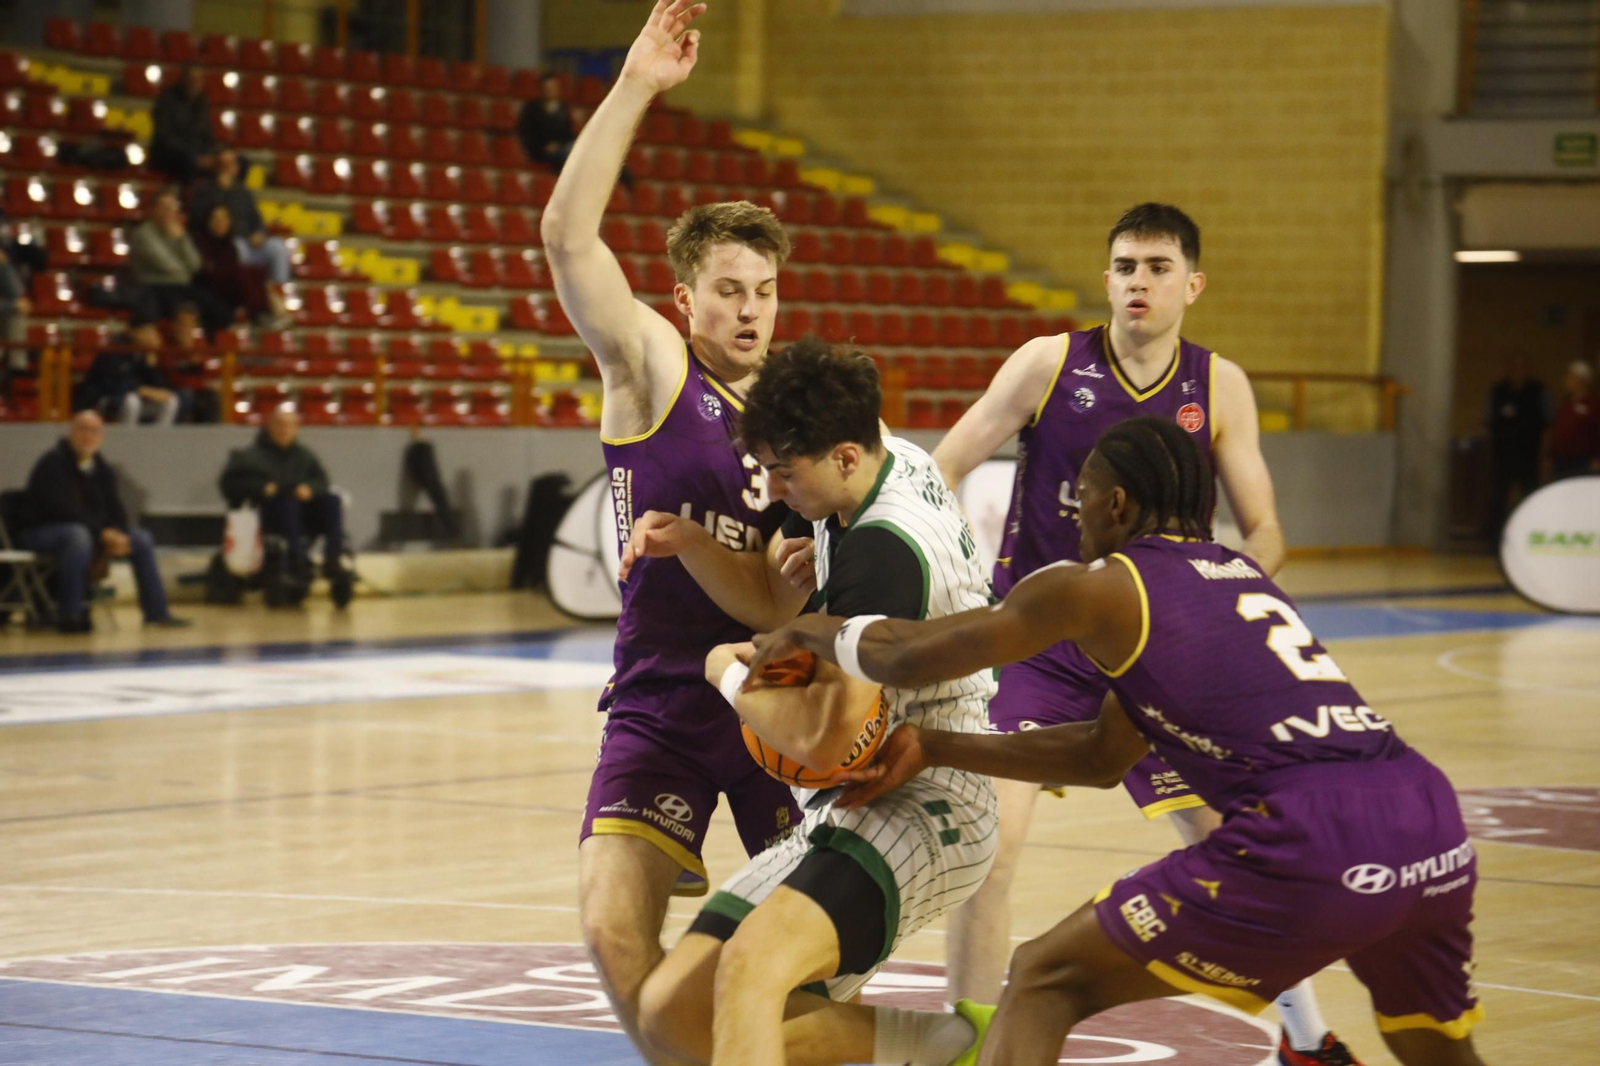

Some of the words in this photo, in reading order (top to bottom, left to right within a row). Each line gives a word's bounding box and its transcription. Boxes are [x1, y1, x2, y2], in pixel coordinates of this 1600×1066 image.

[612, 467, 630, 547] spasia
[1528, 530, 1600, 546] SAN
[1236, 593, 1348, 683] 2
[641, 806, 696, 843] HYUNDAI
[1126, 894, 1167, 938] CBC
